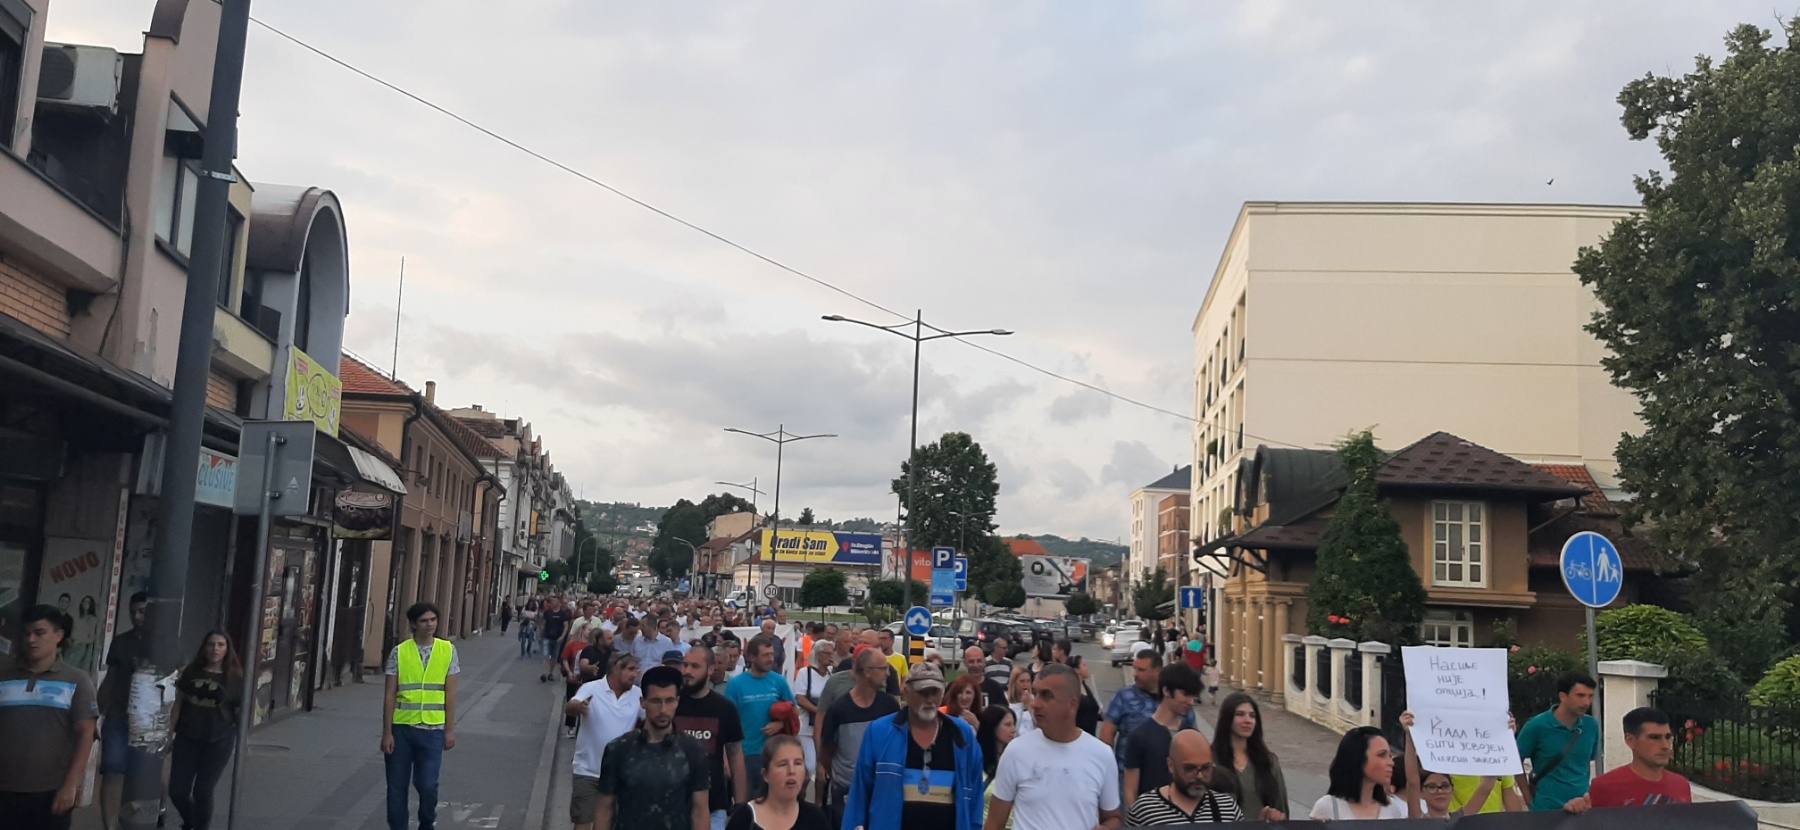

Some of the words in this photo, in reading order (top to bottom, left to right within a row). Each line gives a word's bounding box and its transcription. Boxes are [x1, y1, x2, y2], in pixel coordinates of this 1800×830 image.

[802, 537, 828, 550] Sam
[48, 550, 101, 584] NOVO
[936, 550, 950, 567] P
[766, 588, 777, 596] 30
[106, 583, 118, 633] HAND
